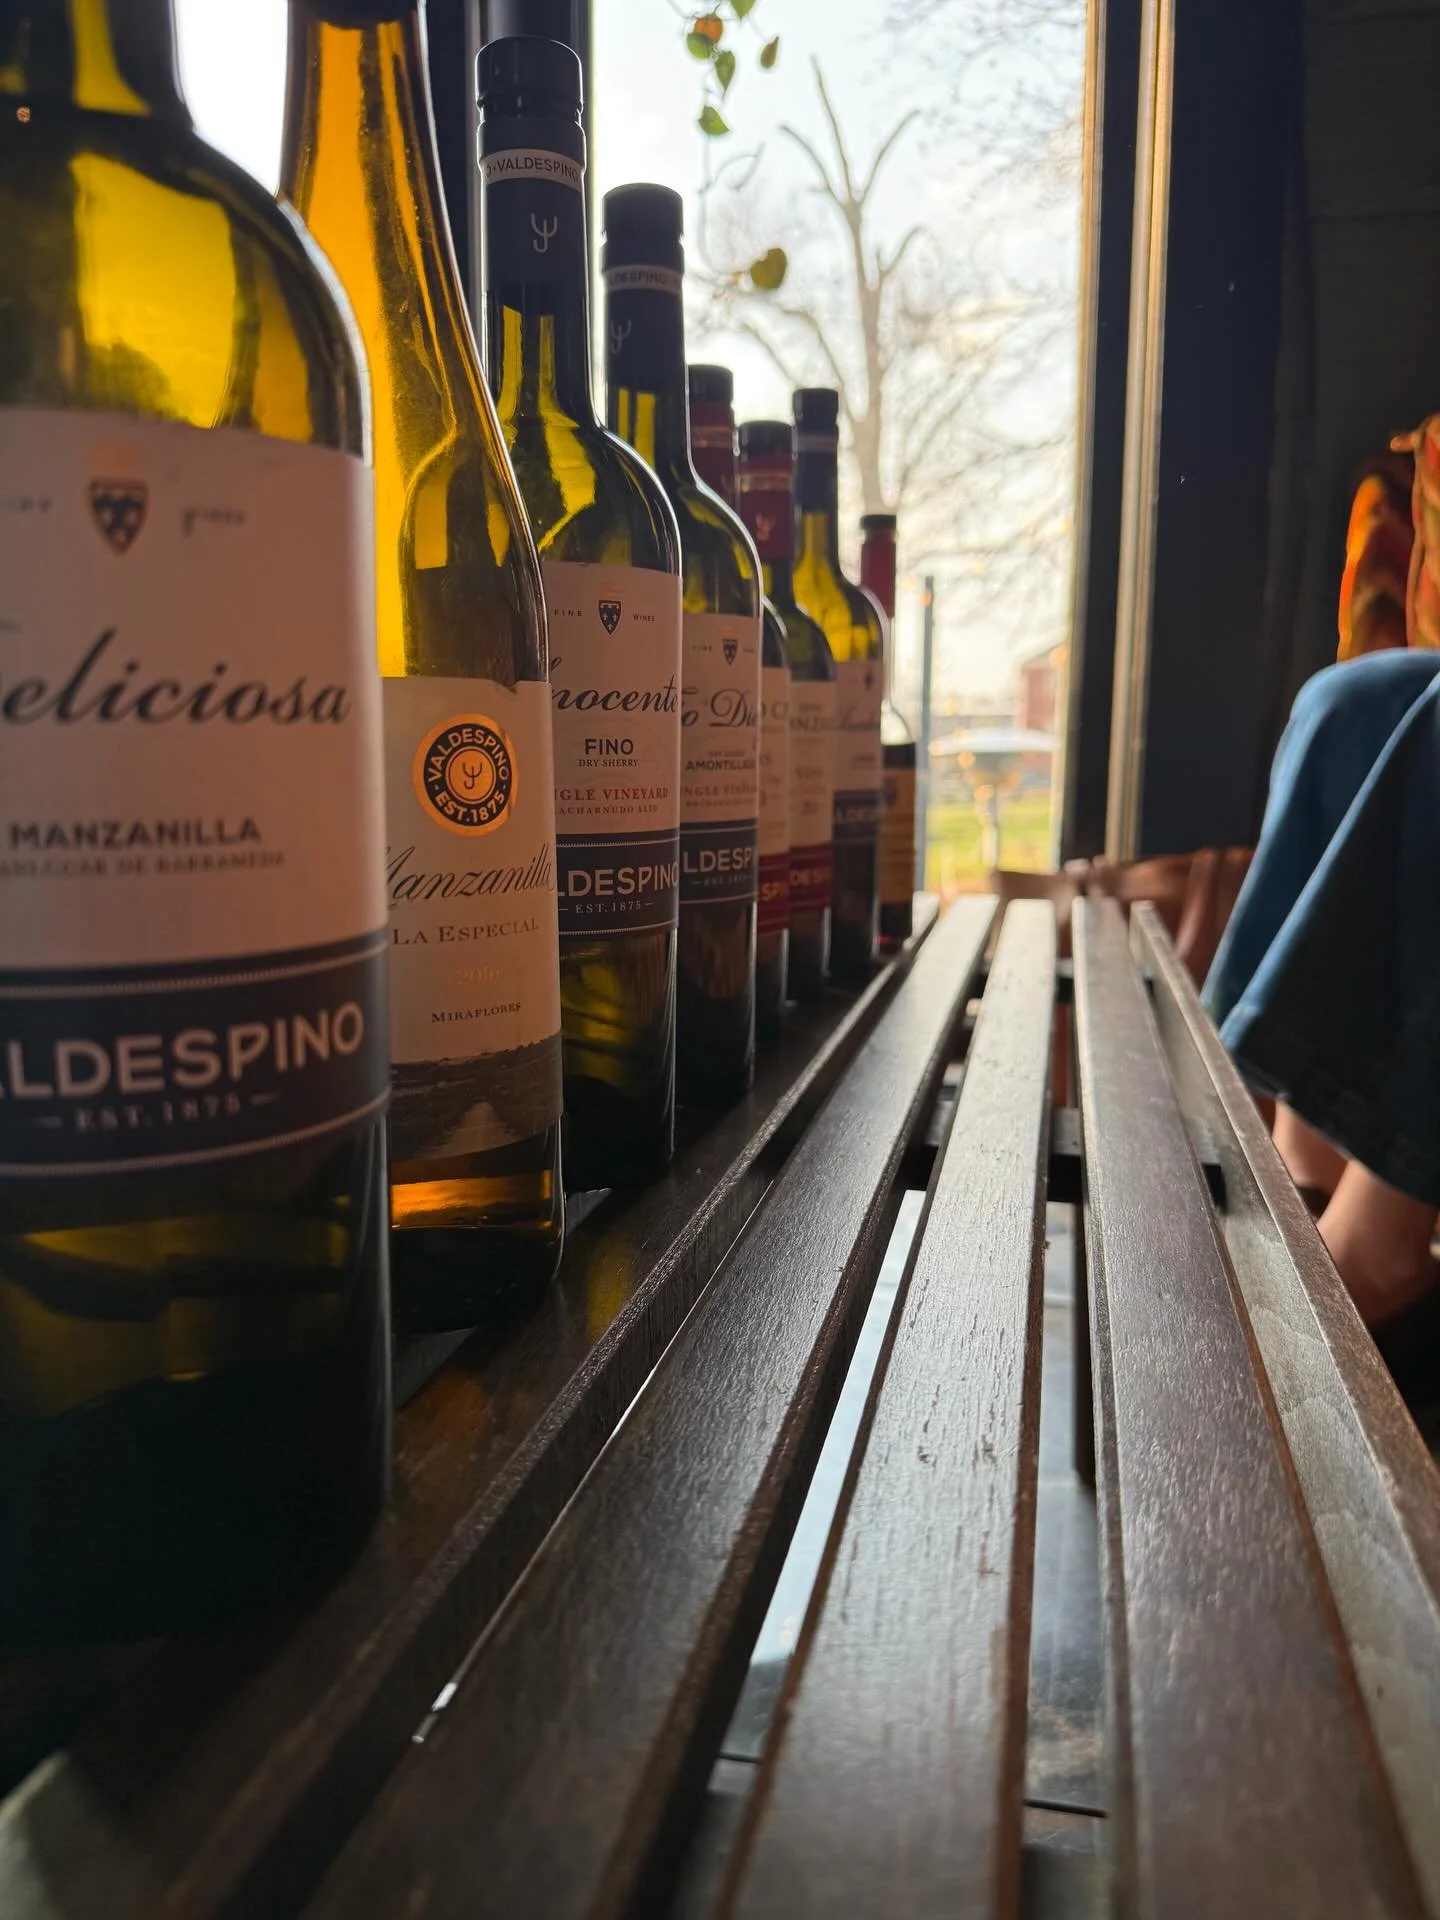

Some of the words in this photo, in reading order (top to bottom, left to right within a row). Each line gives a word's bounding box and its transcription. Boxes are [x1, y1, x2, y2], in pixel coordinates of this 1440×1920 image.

[497, 156, 579, 182] VALDESPINO
[553, 609, 583, 617] FINE
[632, 613, 656, 622] WINES
[0, 626, 351, 725] eliciosa
[426, 727, 510, 783] VALDESPINO
[585, 738, 634, 755] FINO
[578, 759, 600, 768] DRY
[602, 759, 639, 768] SHERRY
[603, 787, 669, 800] VINEYARD
[10, 817, 262, 852] MANZANILLA
[392, 927, 430, 945] LA
[439, 917, 540, 943] ESPECIAL
[431, 1002, 522, 1023] MIRAFLORES
[0, 1001, 365, 1098] LDESPINO
